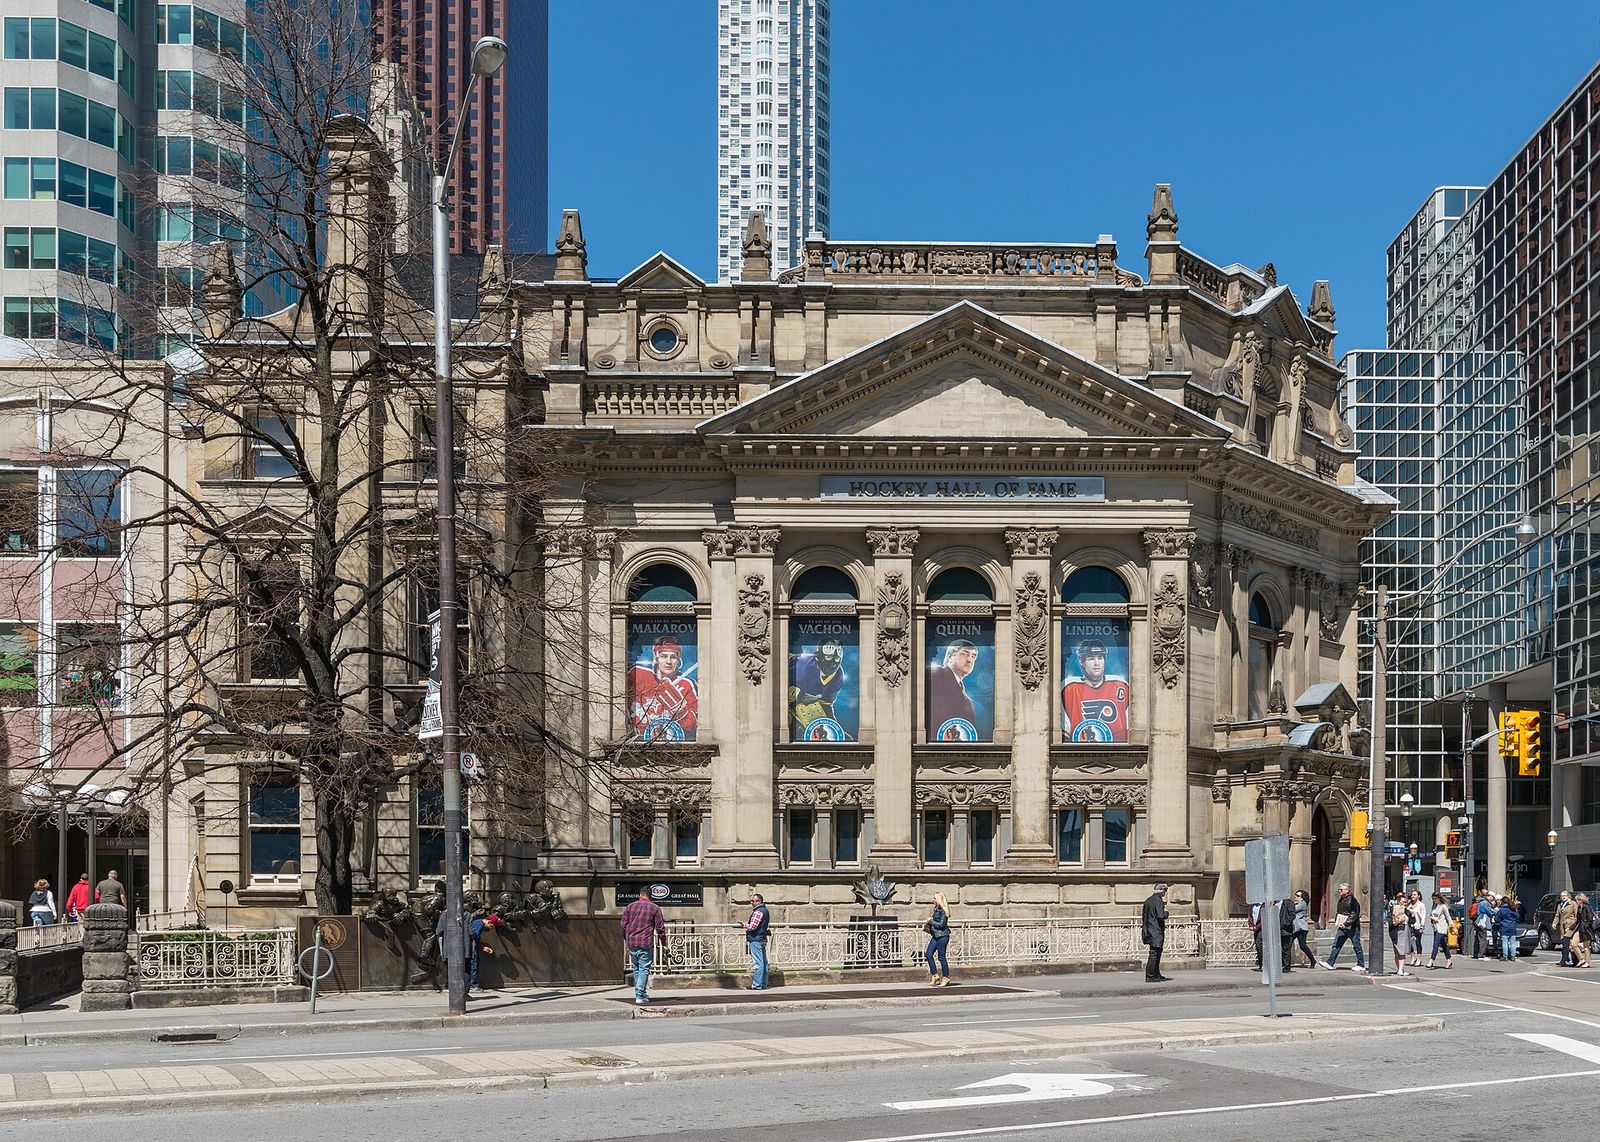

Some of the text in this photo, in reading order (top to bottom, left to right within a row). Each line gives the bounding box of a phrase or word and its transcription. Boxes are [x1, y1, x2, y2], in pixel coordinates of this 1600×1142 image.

[850, 481, 1077, 498] HOCKEY HALL OF FAME
[632, 623, 696, 634] MAKAROV
[798, 624, 851, 635] VACHON
[936, 624, 981, 637] QUINN
[1065, 625, 1120, 636] LINDROS
